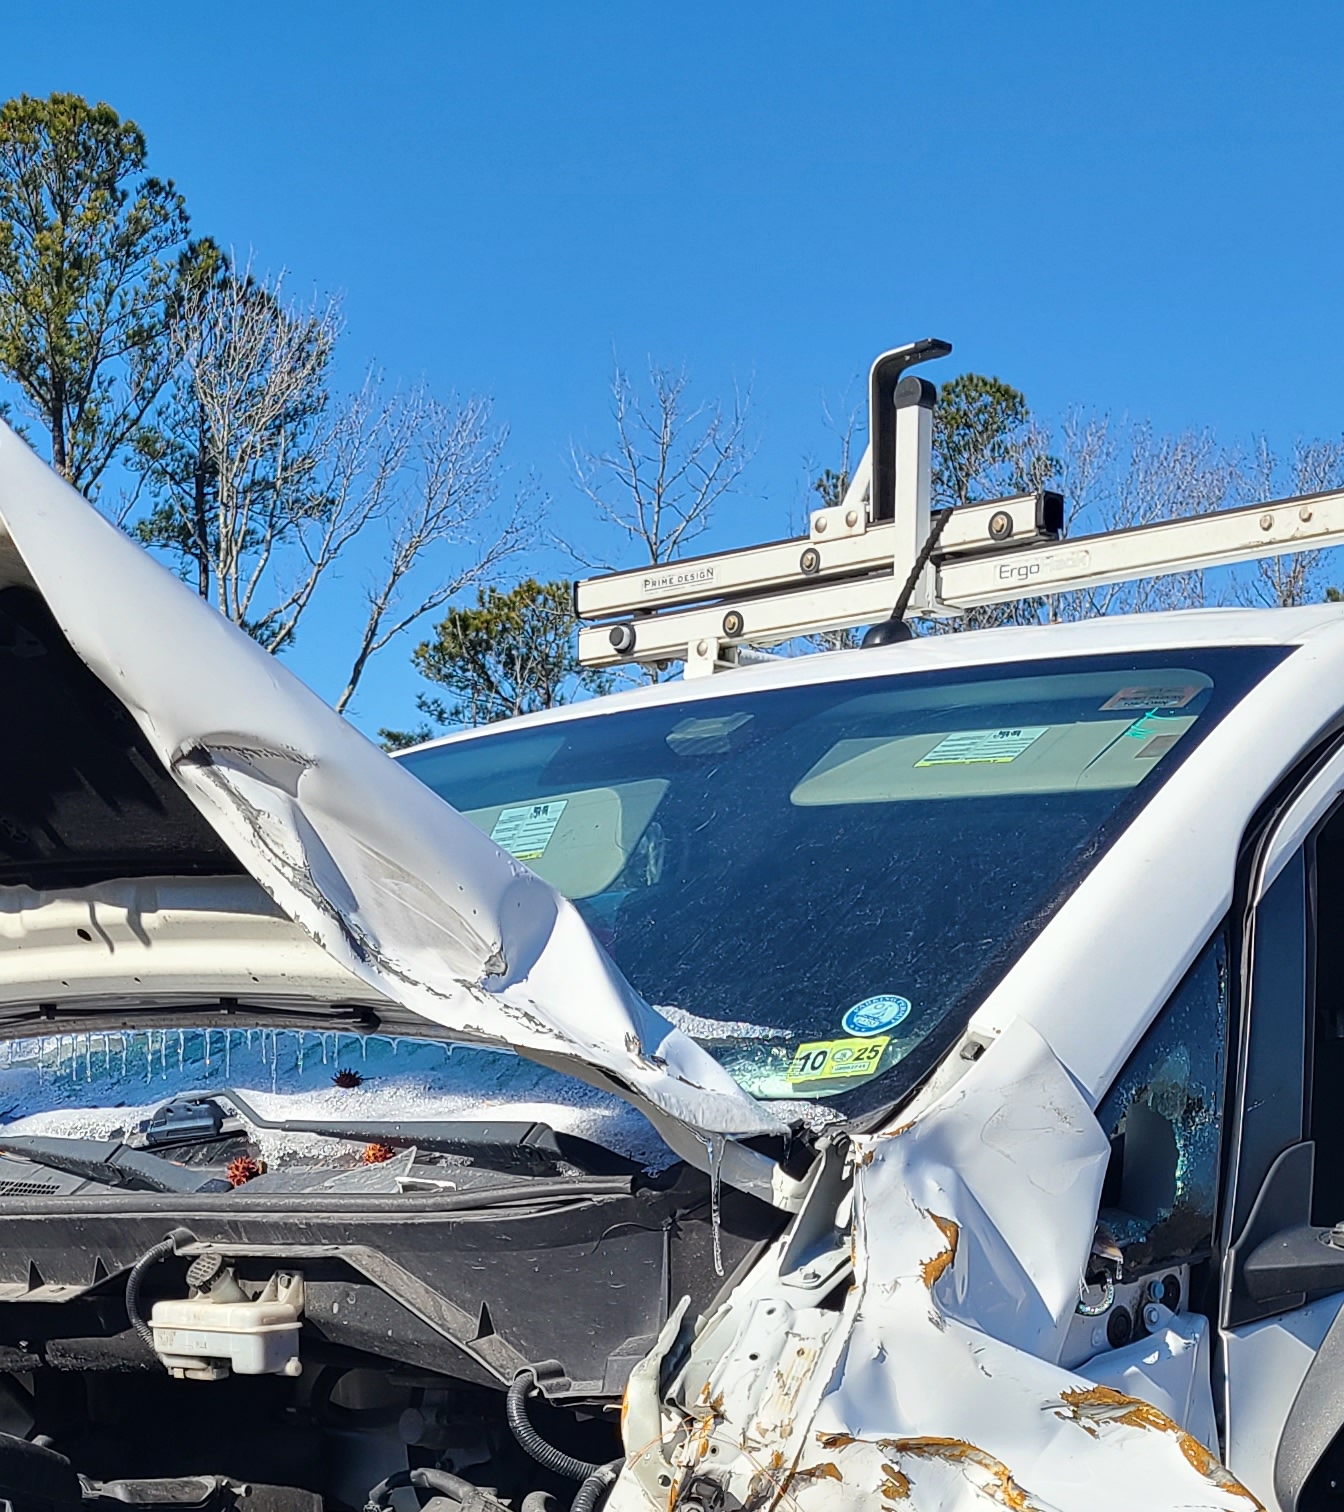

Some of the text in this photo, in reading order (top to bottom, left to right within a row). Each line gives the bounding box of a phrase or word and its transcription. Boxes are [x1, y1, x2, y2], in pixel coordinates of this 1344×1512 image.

[644, 567, 714, 589] PRIME DESIGN
[798, 1044, 882, 1072] 10 25
